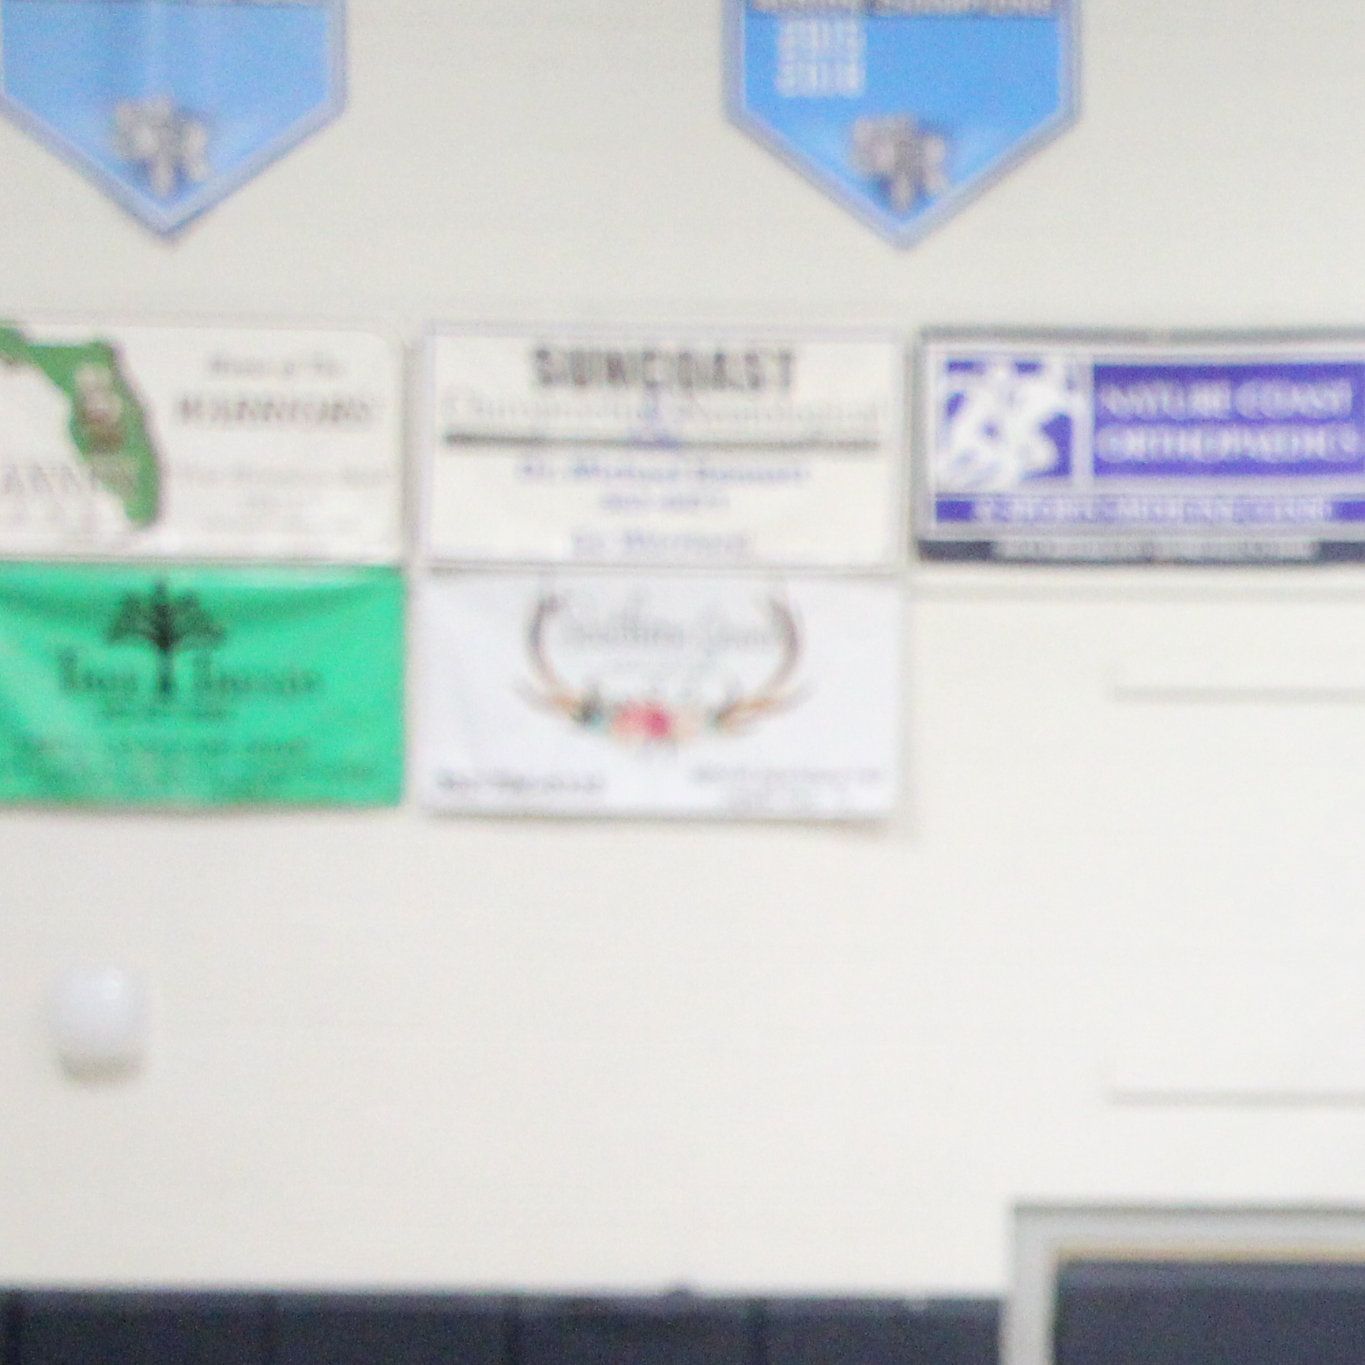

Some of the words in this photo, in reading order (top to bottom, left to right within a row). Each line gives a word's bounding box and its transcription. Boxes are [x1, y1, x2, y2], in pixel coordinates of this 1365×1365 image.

[532, 344, 797, 391] SUNCOAST
[1103, 381, 1233, 418] NATURE
[1239, 380, 1353, 418] COAST
